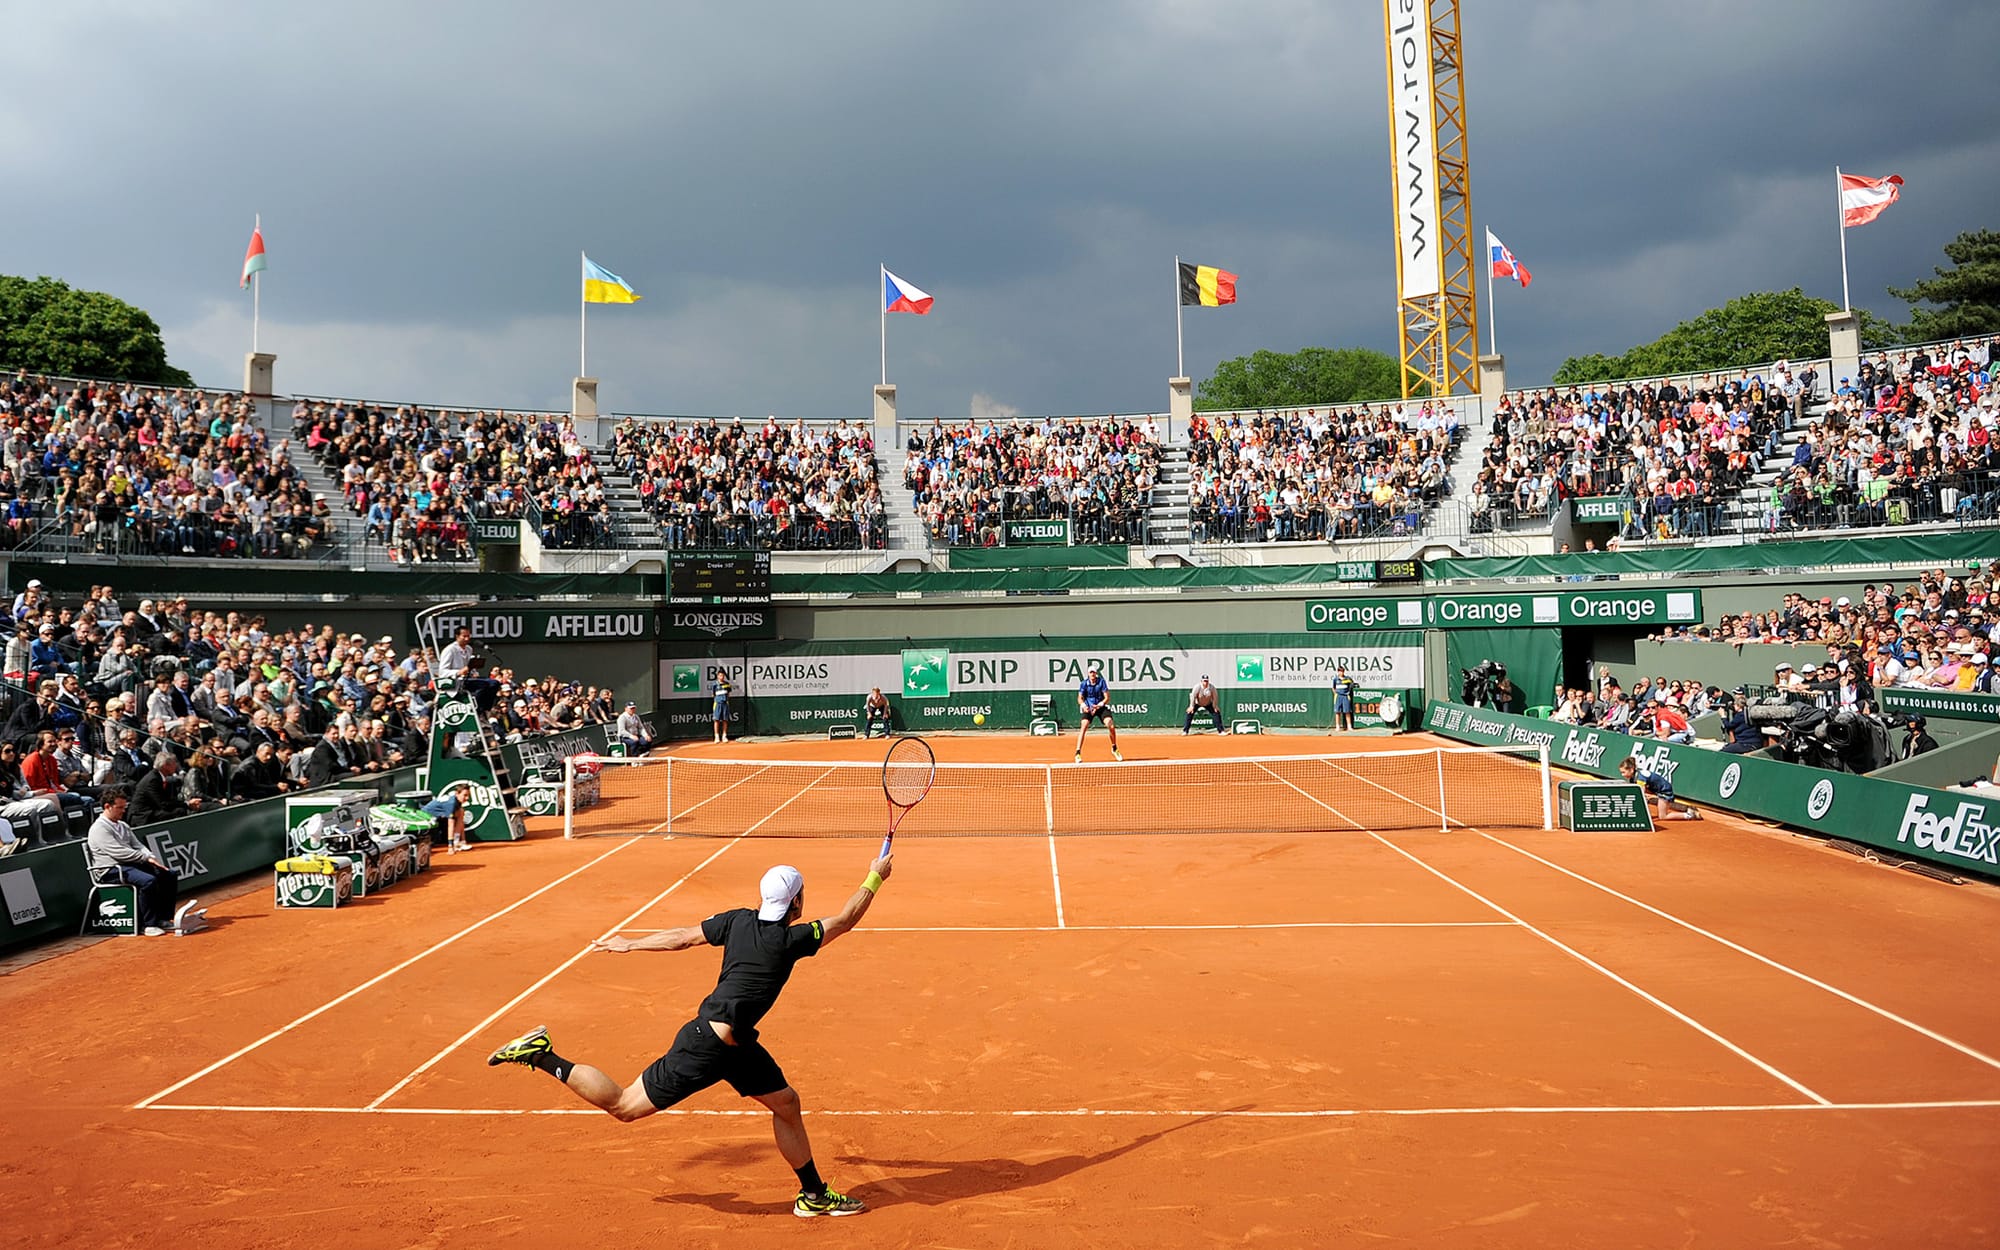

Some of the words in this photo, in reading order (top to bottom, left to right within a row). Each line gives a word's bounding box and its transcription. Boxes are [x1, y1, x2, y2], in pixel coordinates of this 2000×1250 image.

[477, 525, 517, 538] FLELOU
[1011, 525, 1063, 537] AFFLELOU
[754, 552, 769, 562] IBM
[1338, 562, 1373, 578] IBM
[1384, 563, 1409, 576] 209
[1310, 604, 1387, 626] Orange
[1441, 600, 1521, 623] Orange
[1570, 596, 1655, 621] Orange
[545, 614, 644, 637] AFFLELOU
[673, 612, 763, 626] LONGINES
[957, 659, 1018, 684] BNP
[1048, 656, 1176, 683] PARIBAS
[1270, 656, 1308, 671] BNP
[1314, 655, 1393, 671] PARIBAS
[706, 665, 743, 681] BNP
[752, 663, 828, 680] PARIBAS
[1271, 673, 1285, 681] The
[1287, 673, 1306, 681] bank
[1308, 673, 1321, 682] for
[1368, 673, 1392, 681] world
[793, 682, 803, 690] qui
[805, 681, 829, 689] change
[790, 710, 812, 720] BNP
[814, 708, 858, 719] PARIBAS
[924, 706, 946, 716] BNP
[947, 705, 992, 716] PARIBAS
[1237, 703, 1259, 712] BNP
[1262, 702, 1307, 713] PARIBAS
[671, 714, 694, 723] BNP
[1430, 705, 1449, 728] IBM
[1445, 708, 1465, 731] IBM
[1469, 720, 1505, 737] PEUGEOT
[1513, 727, 1555, 747] PEUGEOT
[1561, 729, 1606, 768] FedEx
[1582, 795, 1636, 818] IBM
[1897, 793, 2000, 864] FedEx
[12, 904, 41, 921] orange
[92, 918, 133, 927] LACOSTE
